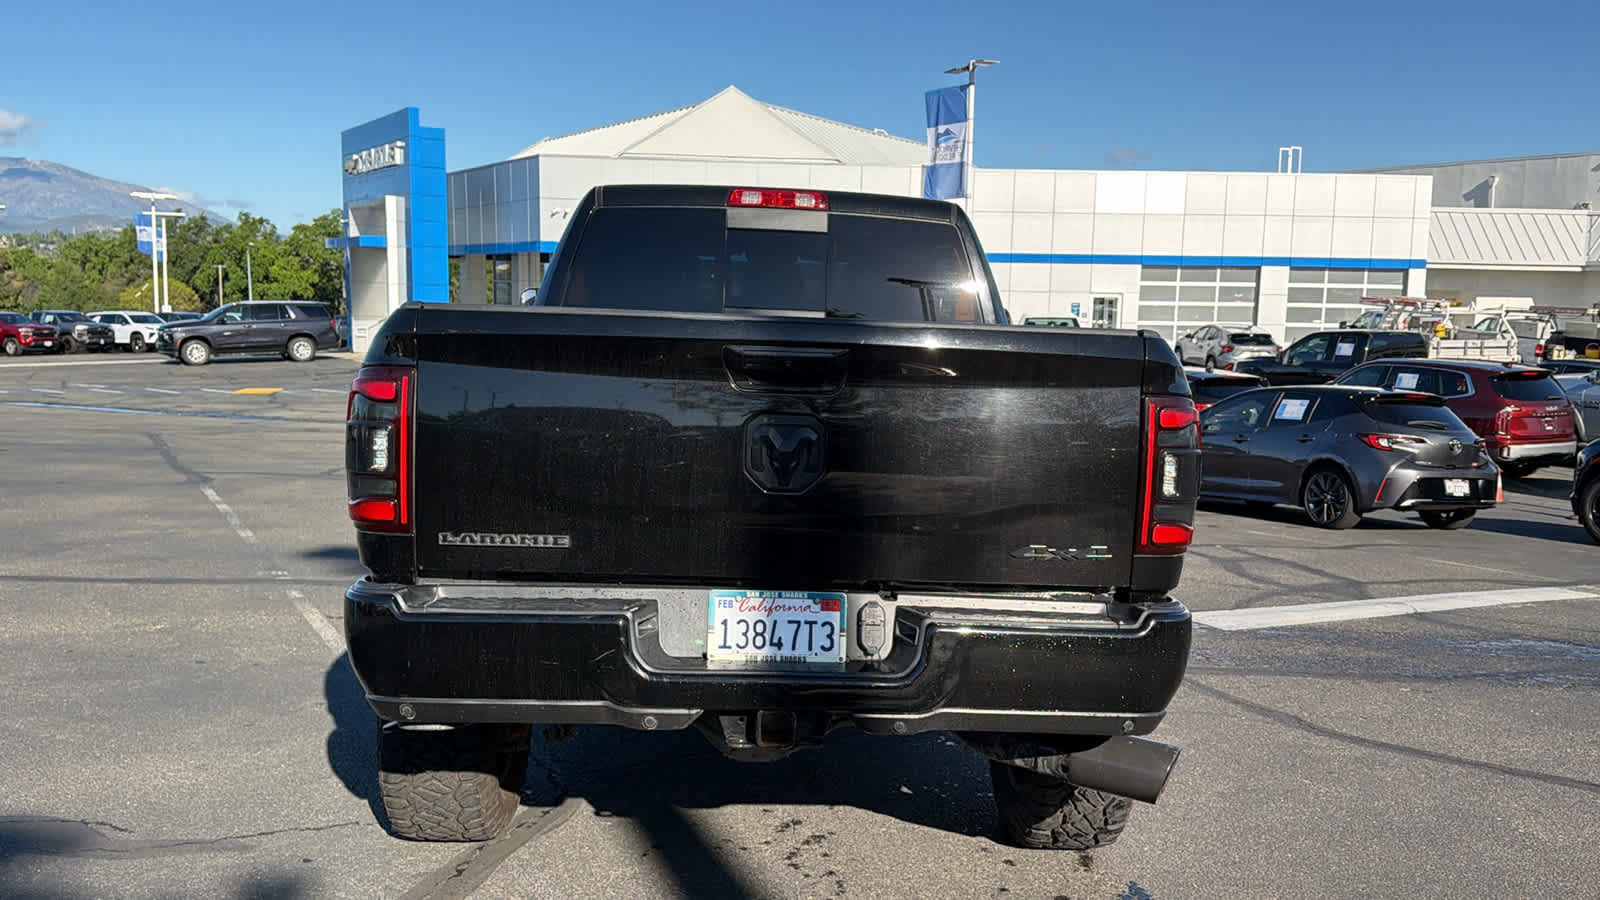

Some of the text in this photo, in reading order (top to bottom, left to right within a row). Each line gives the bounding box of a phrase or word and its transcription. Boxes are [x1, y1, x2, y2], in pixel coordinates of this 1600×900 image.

[438, 532, 570, 548] LARAMIE
[718, 600, 734, 609] FEB
[738, 597, 820, 617] California
[718, 618, 835, 652] 13847T3
